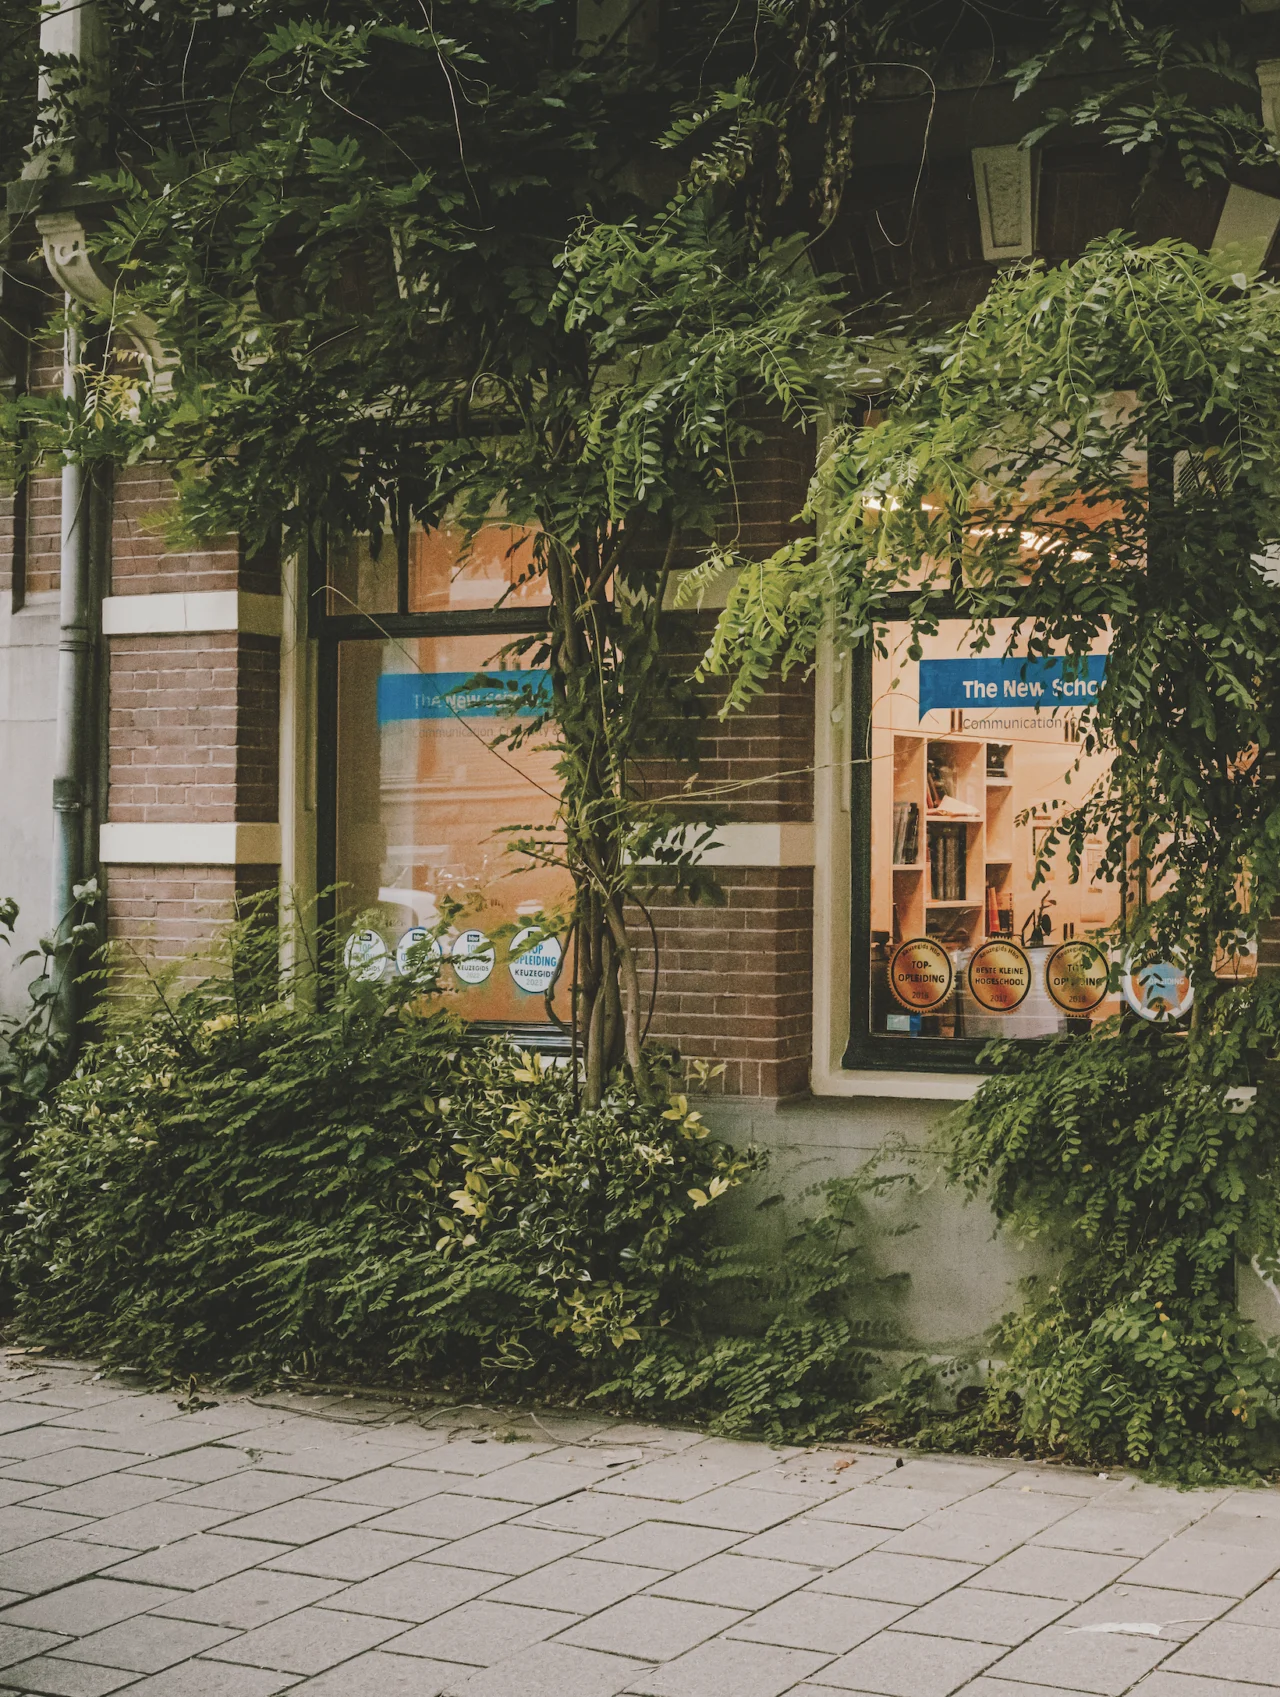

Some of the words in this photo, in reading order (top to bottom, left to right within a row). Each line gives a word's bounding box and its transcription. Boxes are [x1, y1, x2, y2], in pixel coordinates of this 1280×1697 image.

[963, 679, 998, 699] The
[1003, 679, 1045, 698] New
[1051, 678, 1107, 697] Scho
[413, 694, 441, 709] The
[444, 693, 481, 709] New
[514, 954, 557, 967] OPLEIDING
[912, 960, 932, 969] TOP-
[515, 969, 555, 978] KEUZEGIDS
[976, 967, 997, 975] BESTE
[999, 967, 1024, 975] KLEINE
[898, 973, 945, 984] OPLEIDING
[975, 978, 1025, 986] HOGESCHOOL
